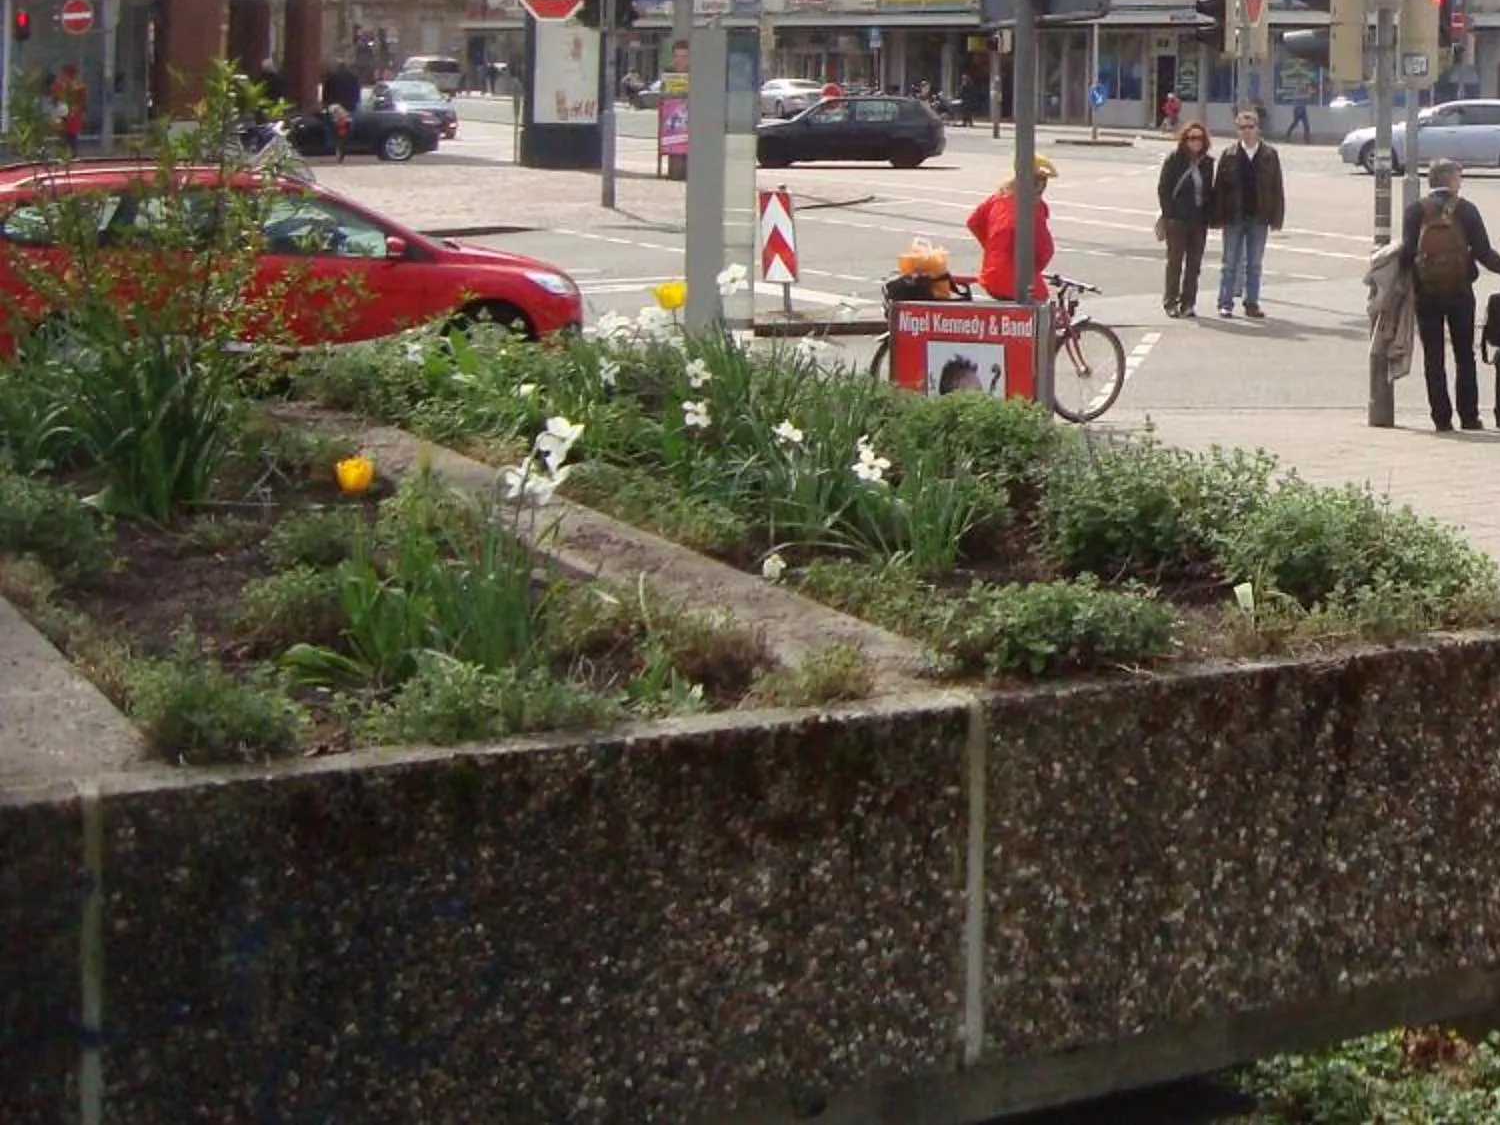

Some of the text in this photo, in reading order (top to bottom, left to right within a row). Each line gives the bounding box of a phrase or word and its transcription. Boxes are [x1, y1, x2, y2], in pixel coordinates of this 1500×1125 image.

[899, 310, 1033, 339] Nigel Kennedy & Band
